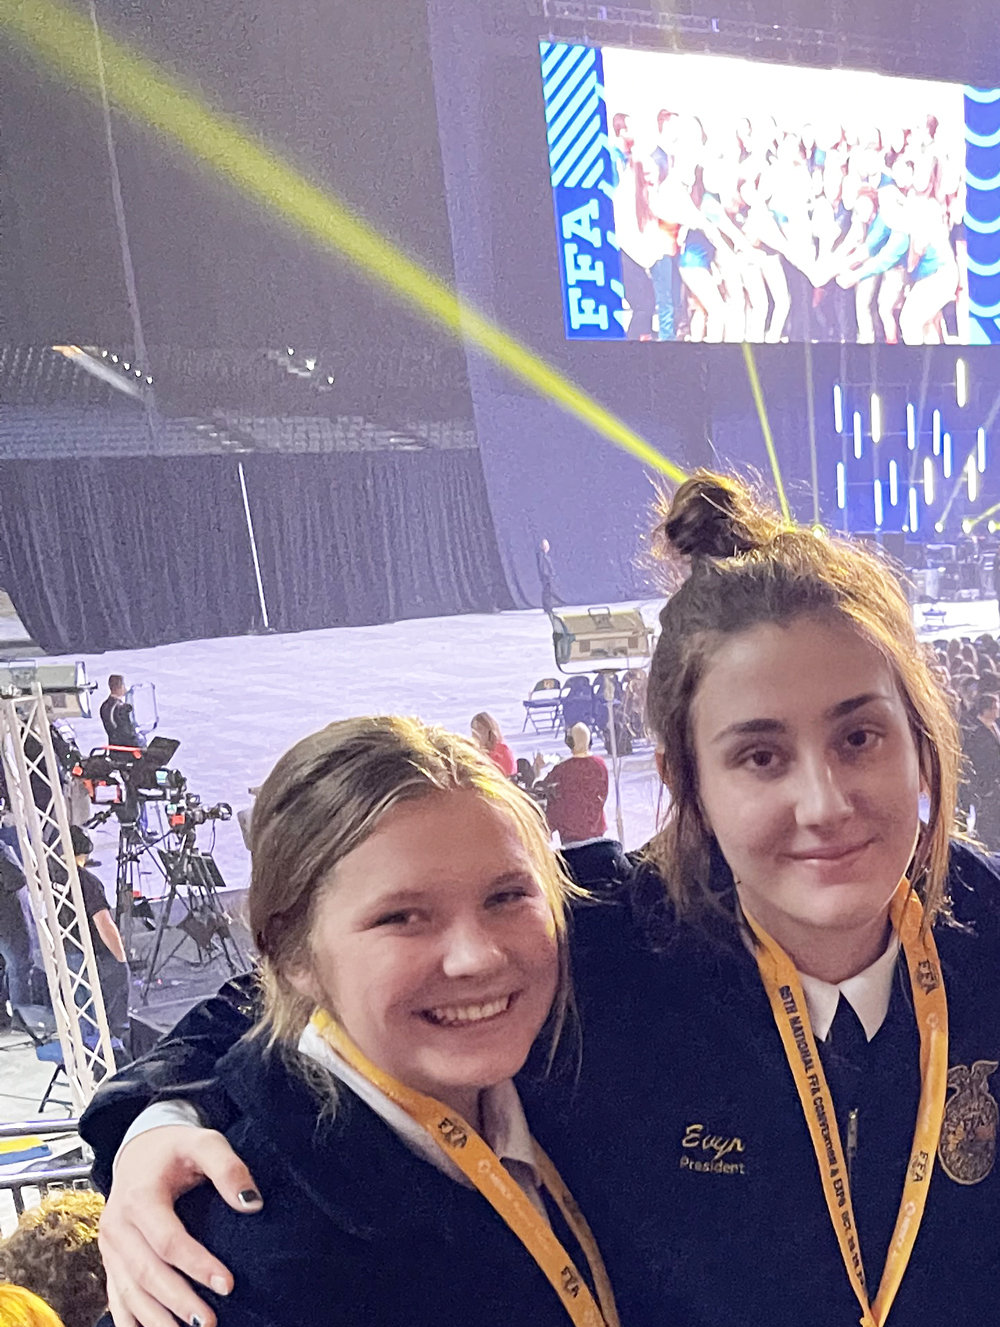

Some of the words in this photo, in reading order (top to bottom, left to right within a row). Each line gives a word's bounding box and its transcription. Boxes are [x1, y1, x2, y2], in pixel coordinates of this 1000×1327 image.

[562, 199, 609, 330] FFA
[789, 1016, 814, 1073] NATIONAL
[808, 1074, 820, 1096] FFA
[680, 1155, 745, 1175] President
[913, 1151, 929, 1183] FFA
